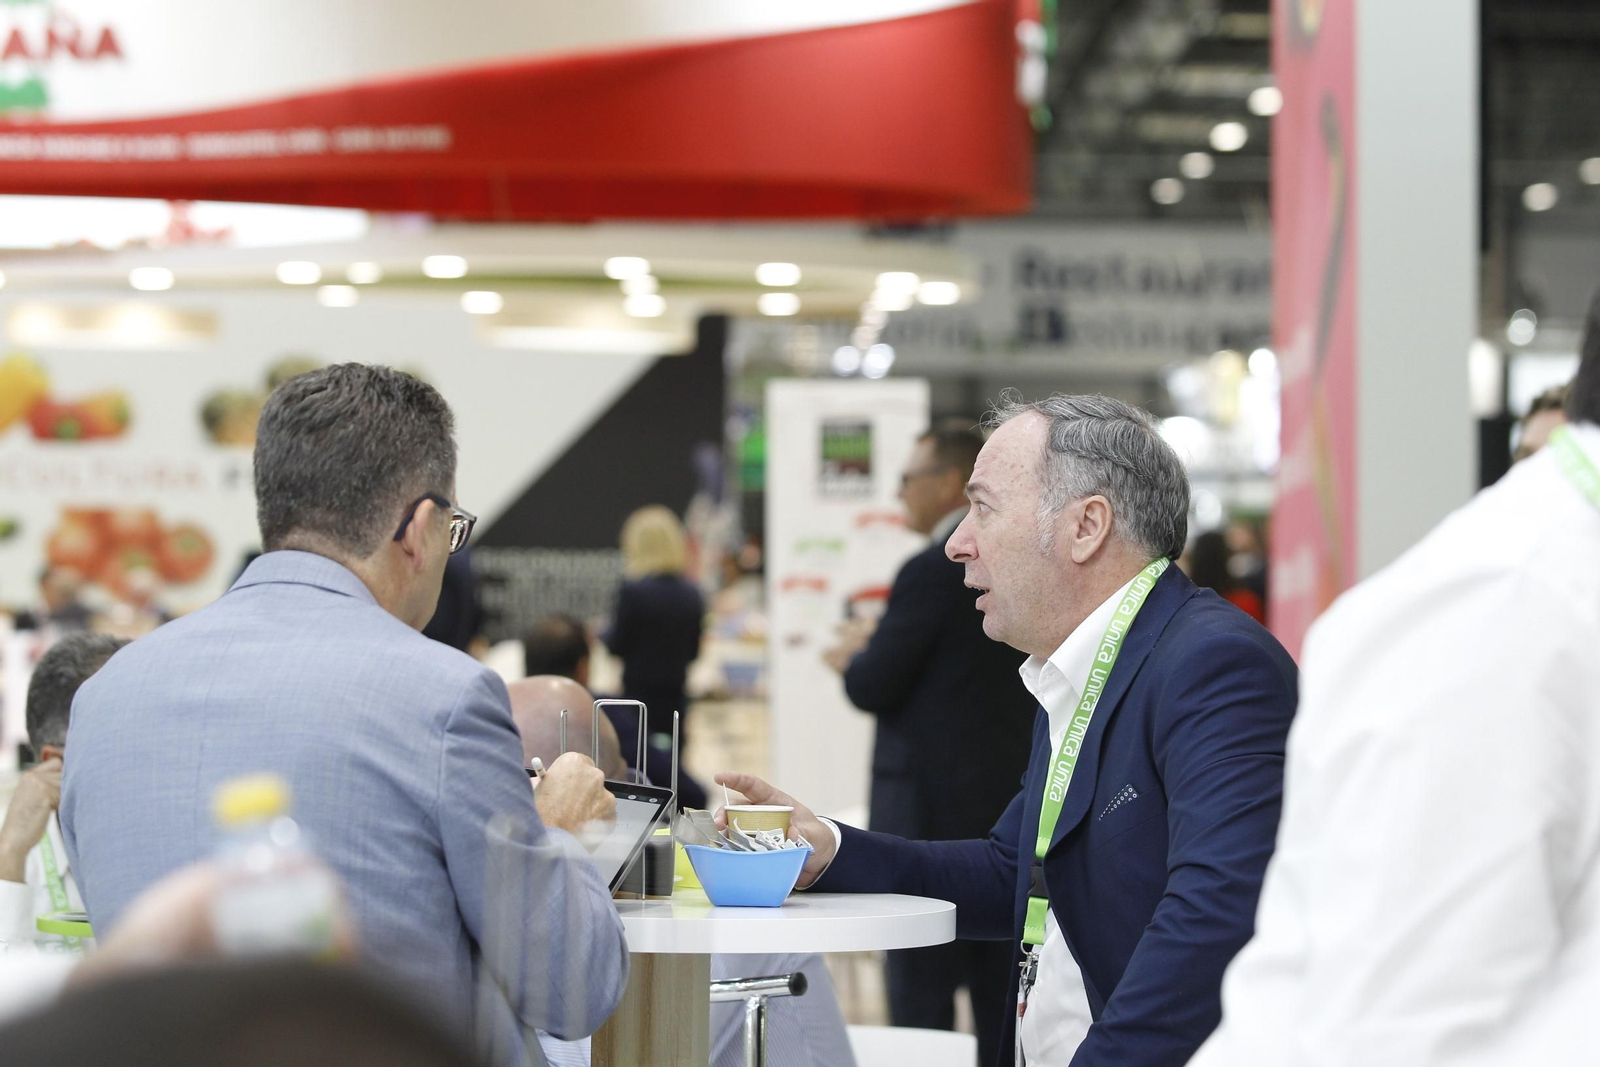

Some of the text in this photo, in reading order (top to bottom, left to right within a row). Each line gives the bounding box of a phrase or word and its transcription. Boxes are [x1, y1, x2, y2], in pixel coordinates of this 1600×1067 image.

[1097, 619, 1126, 664] unica
[1062, 715, 1089, 758] unica
[1049, 760, 1072, 803] unica
